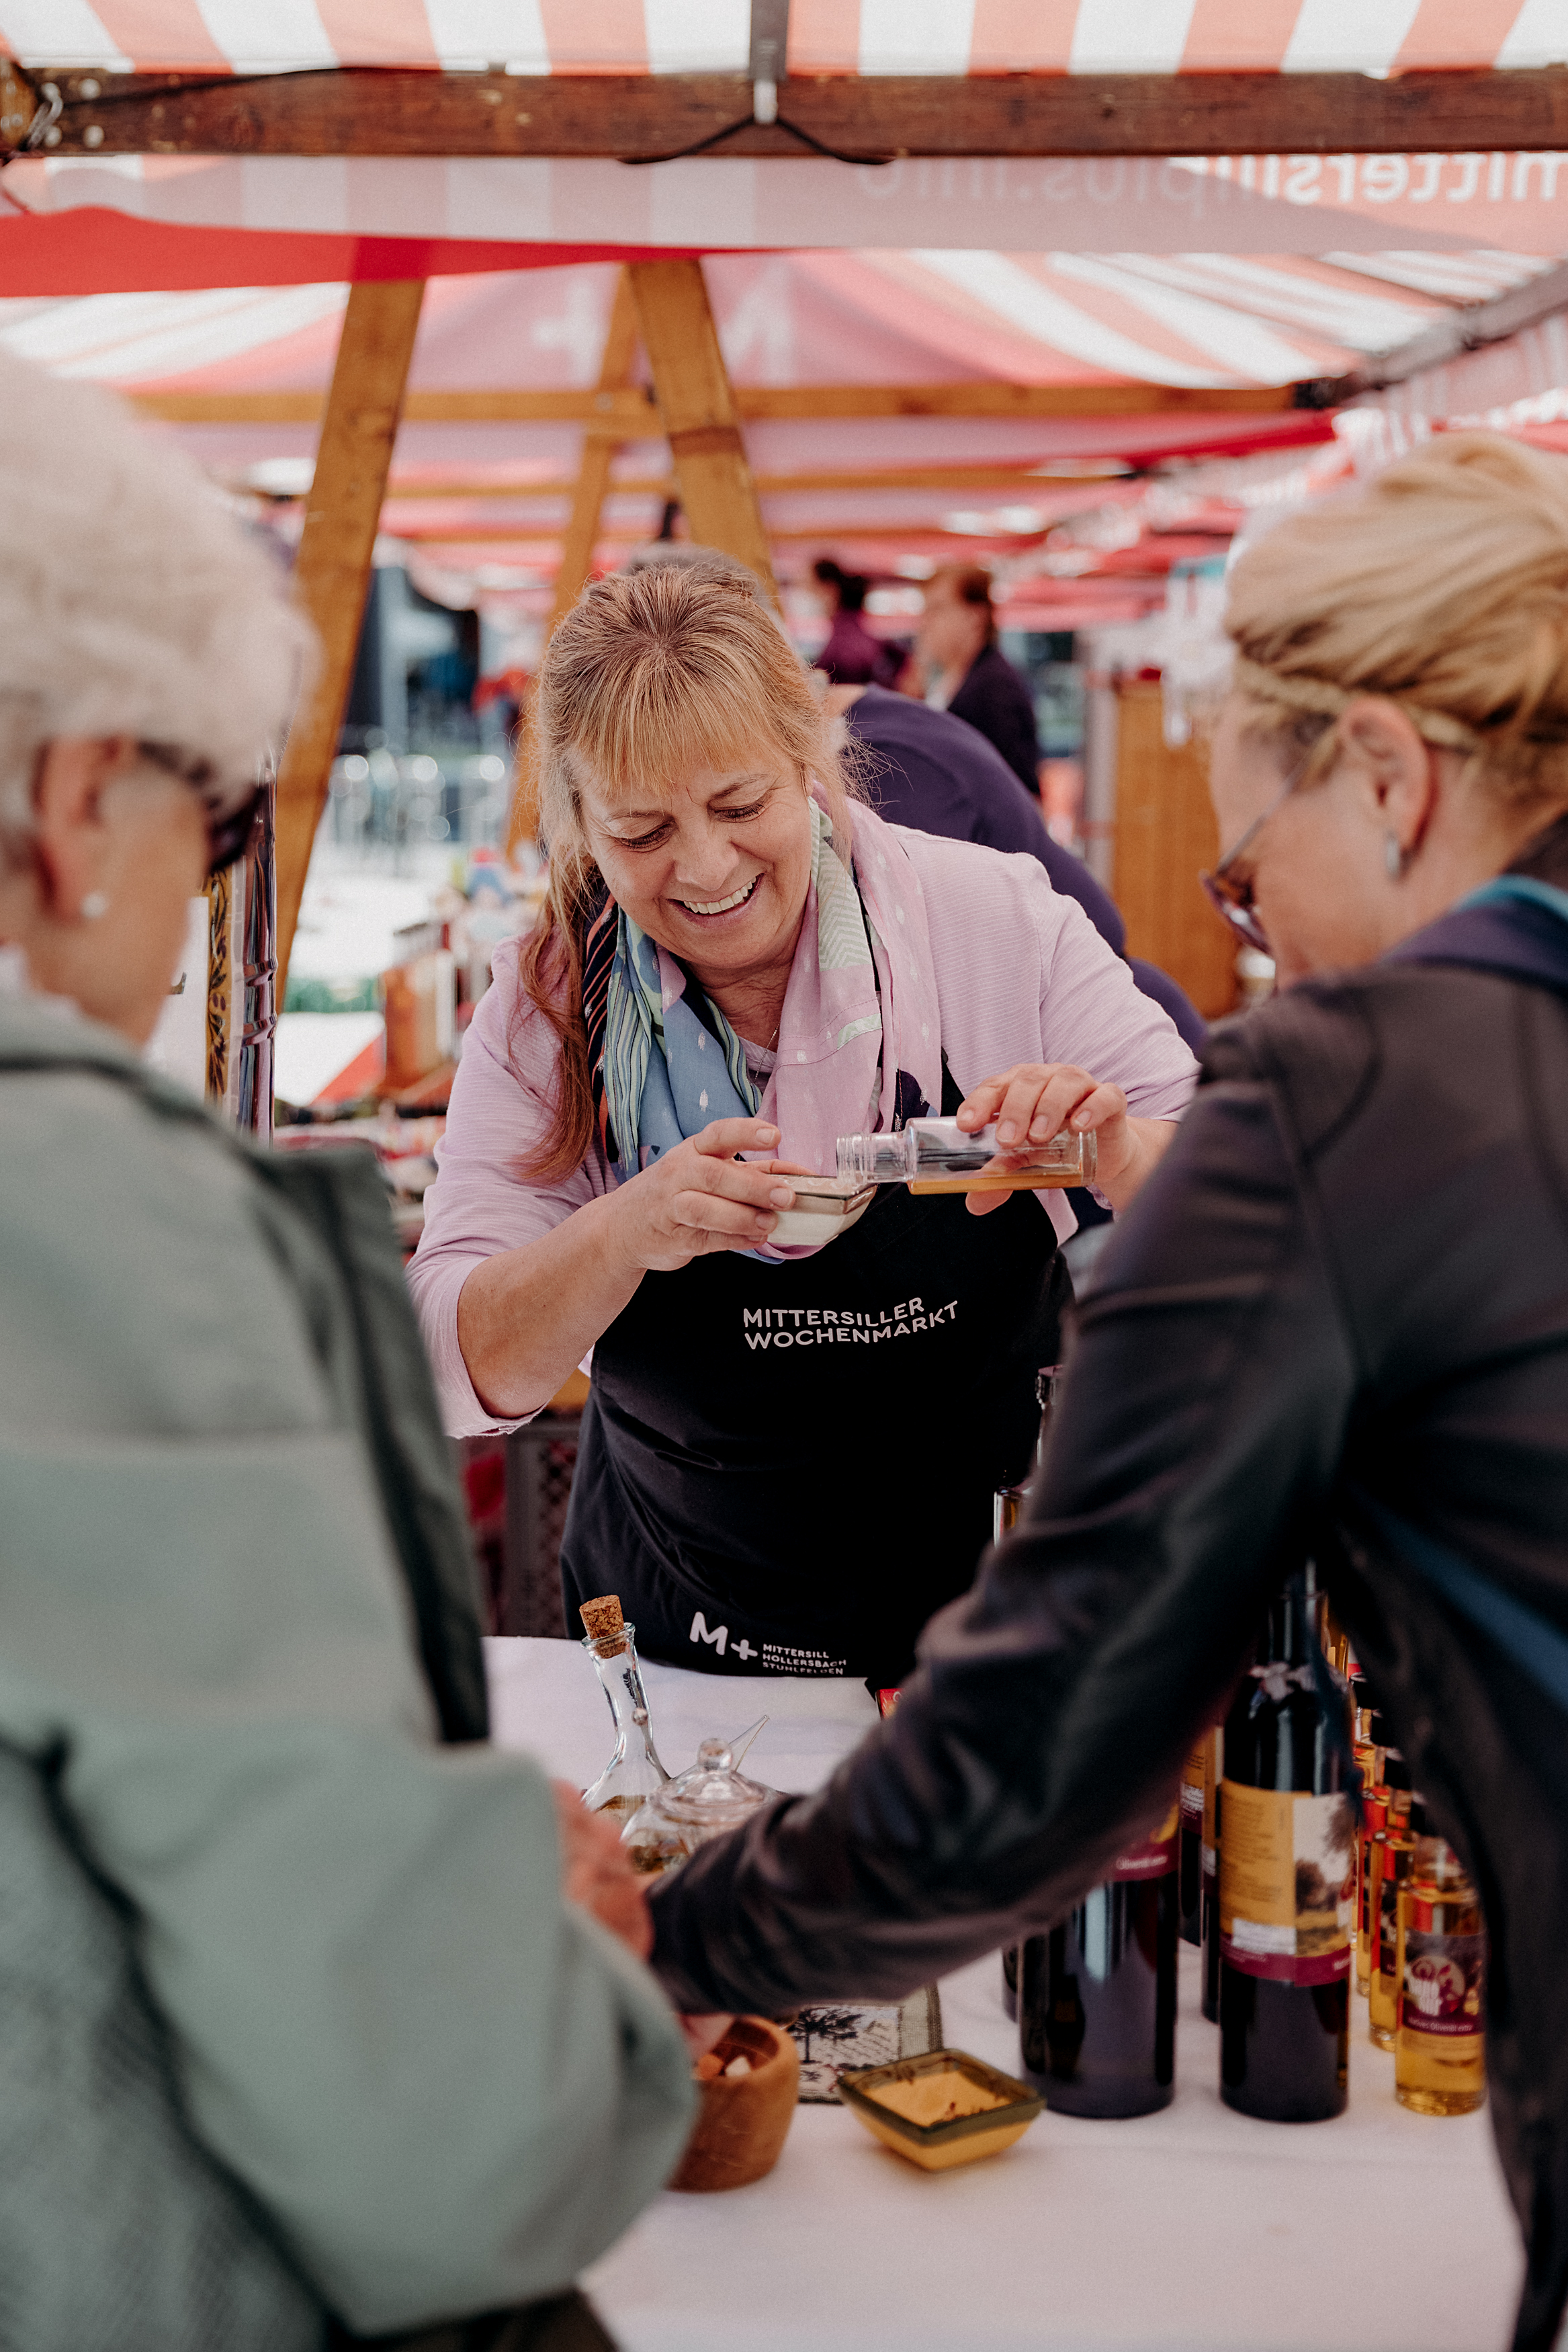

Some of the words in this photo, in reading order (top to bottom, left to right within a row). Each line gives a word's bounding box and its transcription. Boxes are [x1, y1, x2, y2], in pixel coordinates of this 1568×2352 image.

[743, 1297, 924, 1328] MITTERSILLER
[744, 1300, 958, 1350] WOCHENMARKT
[763, 1643, 830, 1658] MITTERSILL
[763, 1653, 846, 1668] HOLLERSBACH
